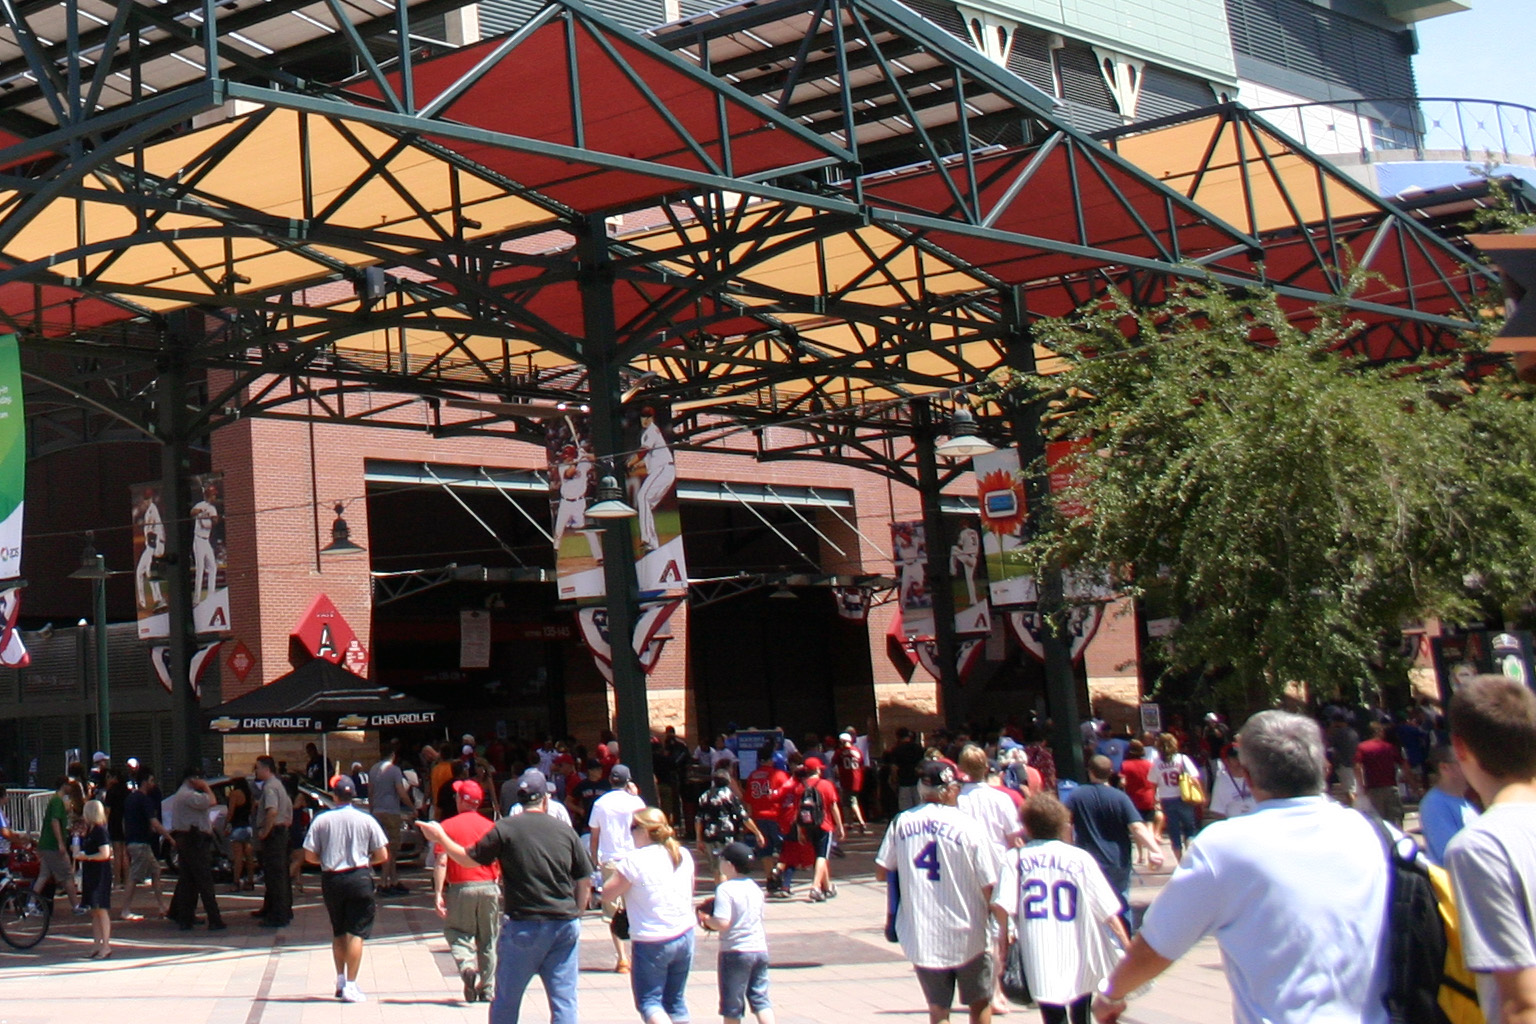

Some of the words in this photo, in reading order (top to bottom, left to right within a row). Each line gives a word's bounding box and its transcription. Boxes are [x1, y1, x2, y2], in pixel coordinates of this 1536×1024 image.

[243, 717, 311, 729] CHEVROLET
[371, 712, 436, 726] CHEVROLET
[899, 818, 963, 846] COUNSELL
[914, 841, 941, 882] 4
[1022, 878, 1078, 922] 20
